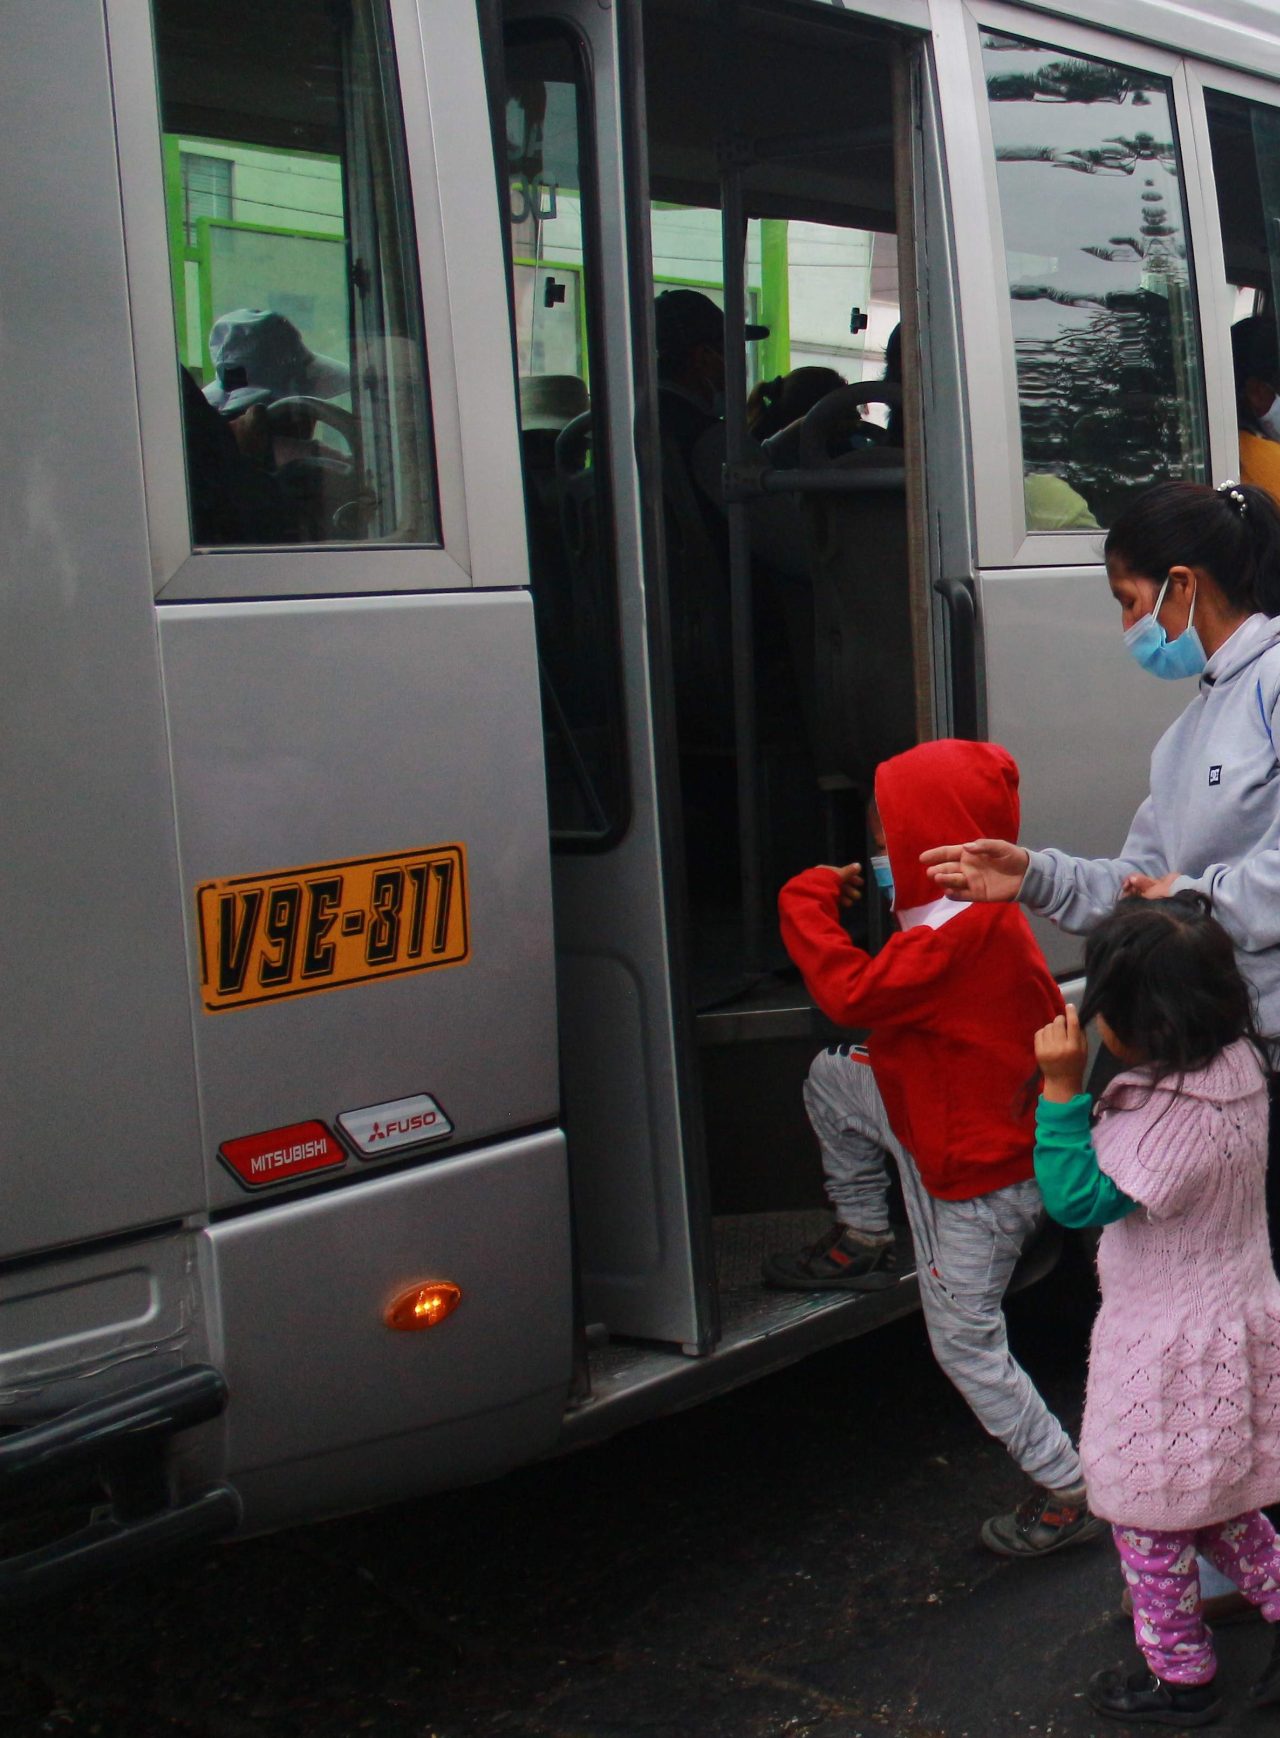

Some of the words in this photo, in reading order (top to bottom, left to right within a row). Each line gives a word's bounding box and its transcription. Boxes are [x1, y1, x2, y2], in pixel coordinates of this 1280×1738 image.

[216, 858, 454, 997] V9E-811
[385, 1111, 437, 1138] FUSO
[251, 1138, 327, 1175] MITSUBISHI
